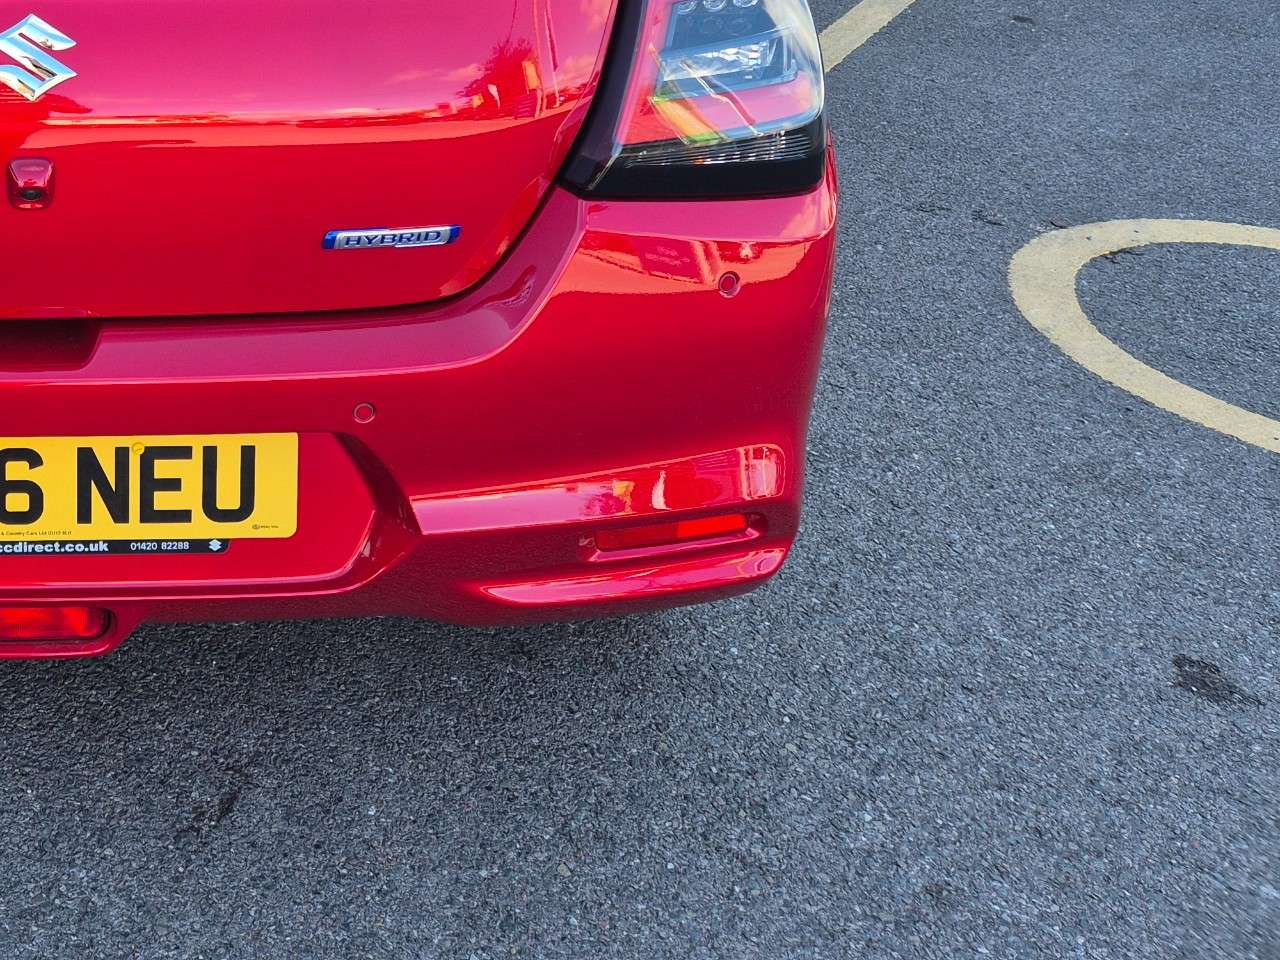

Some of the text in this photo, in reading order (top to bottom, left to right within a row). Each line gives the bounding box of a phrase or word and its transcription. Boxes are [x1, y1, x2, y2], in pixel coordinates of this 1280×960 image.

[344, 230, 441, 246] HYBRID
[76, 445, 256, 525] NEU
[130, 542, 158, 551] 01420
